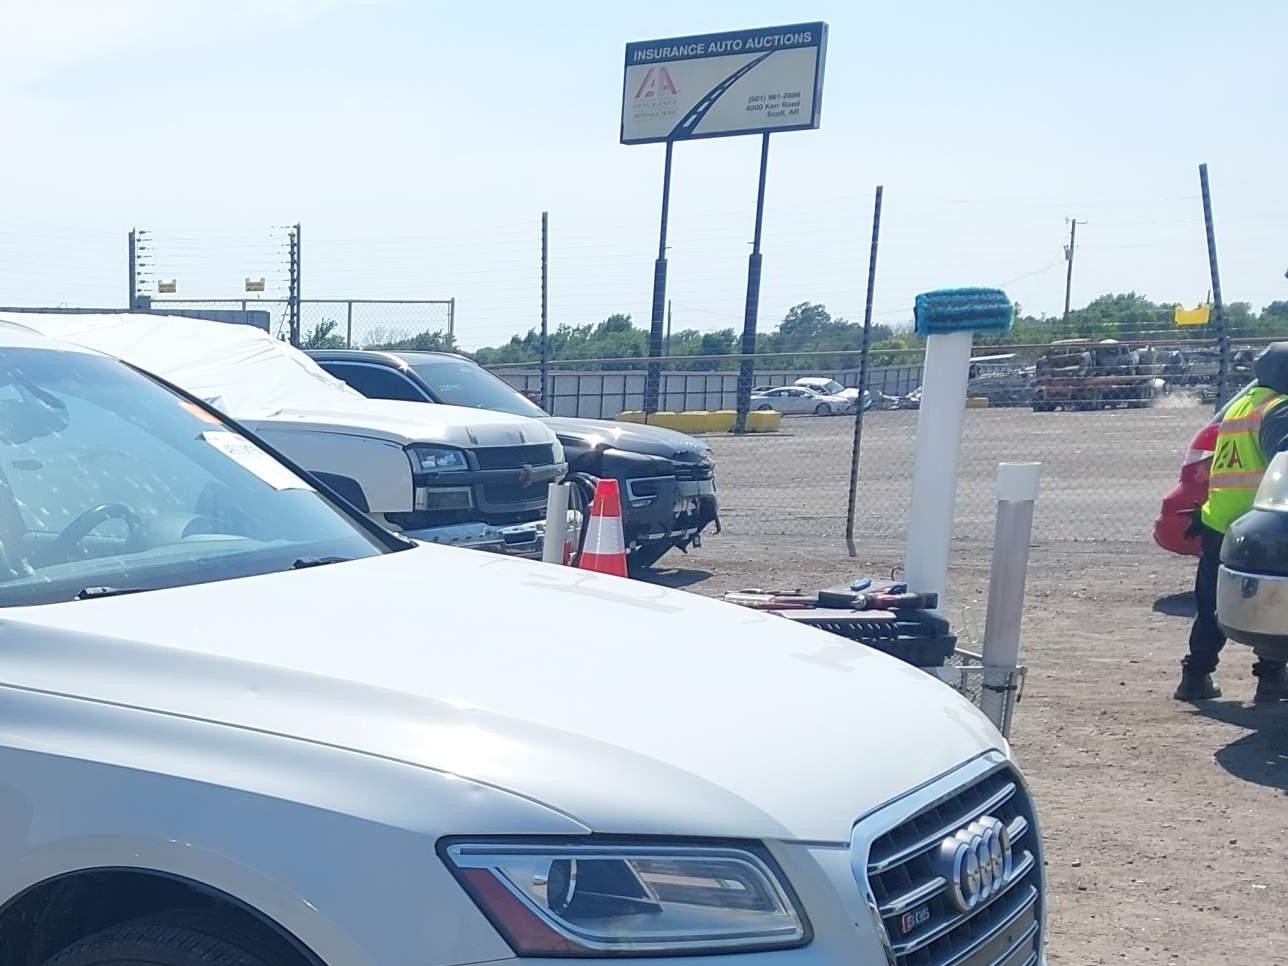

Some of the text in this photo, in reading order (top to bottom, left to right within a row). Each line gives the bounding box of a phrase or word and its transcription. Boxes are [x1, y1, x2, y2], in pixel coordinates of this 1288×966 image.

[633, 31, 813, 61] INSURANCE AUTO AUCTIONS
